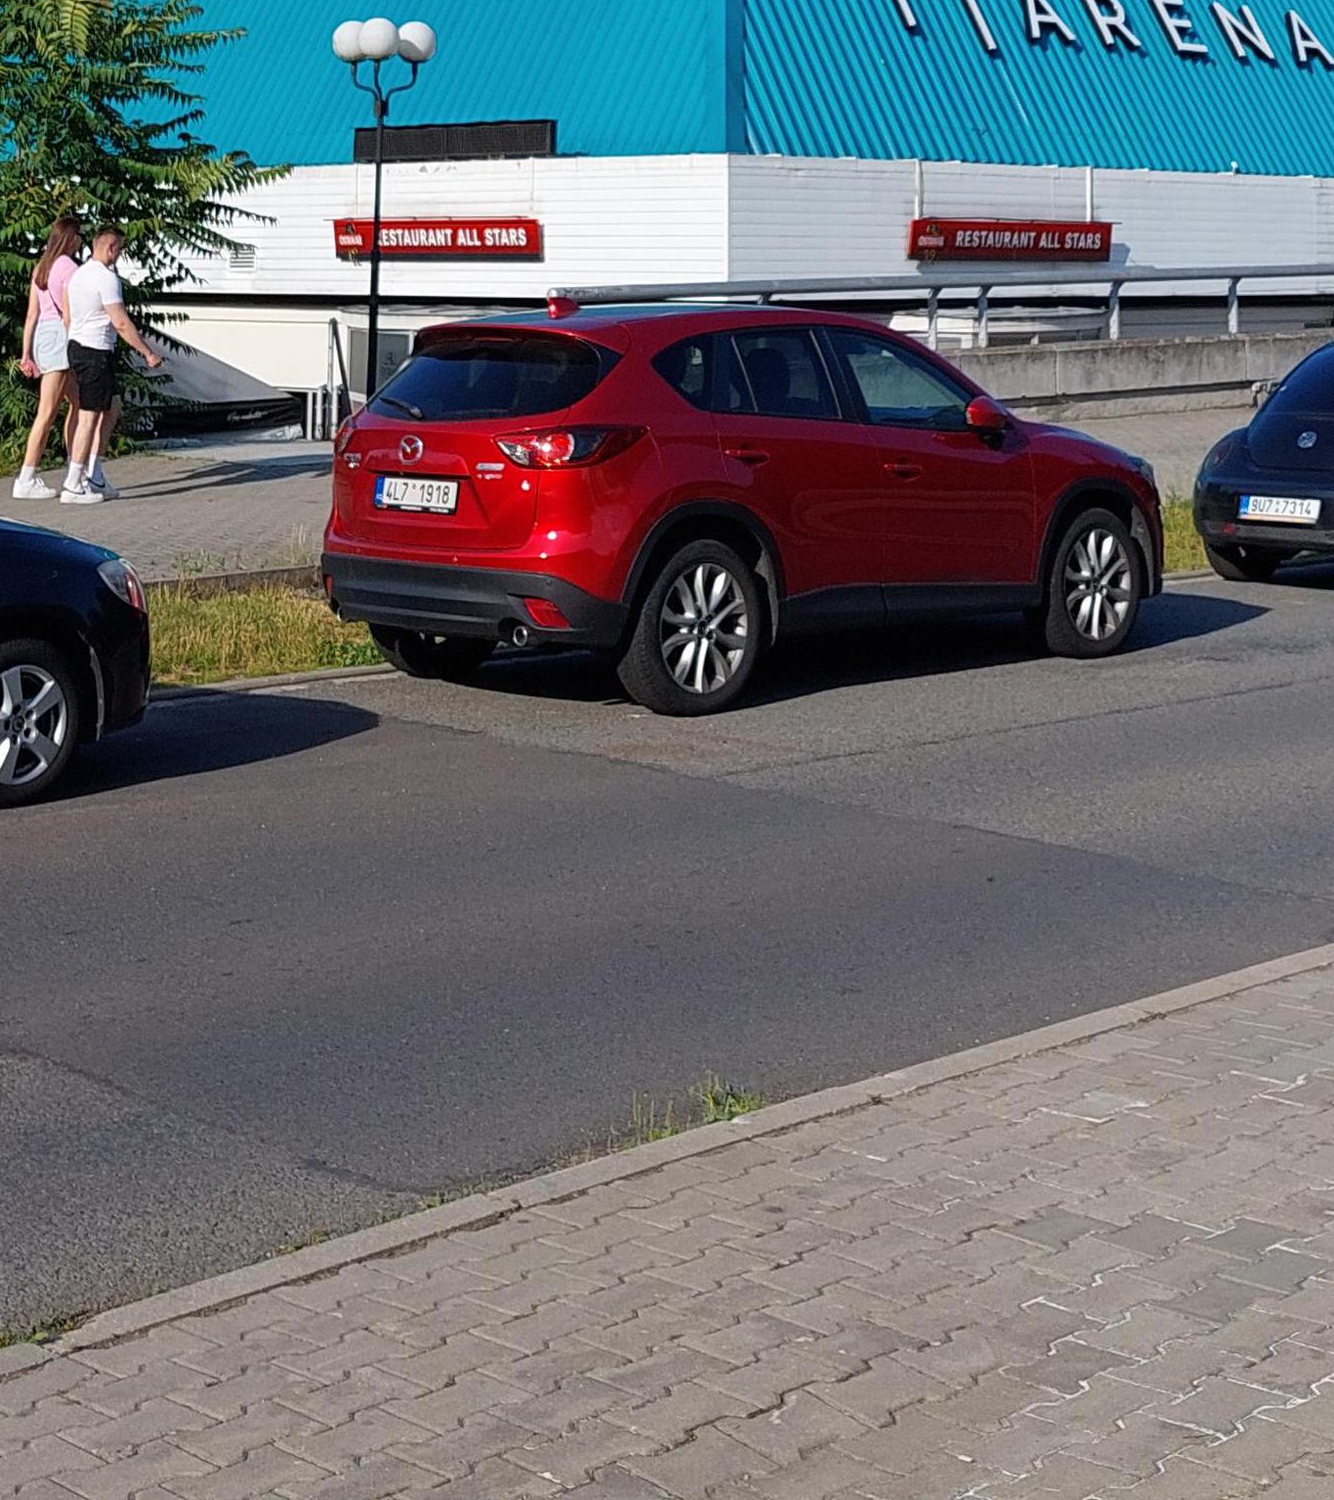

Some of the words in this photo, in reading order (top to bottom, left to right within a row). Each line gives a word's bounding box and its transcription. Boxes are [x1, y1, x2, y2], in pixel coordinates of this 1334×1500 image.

[456, 228, 481, 246] ALL
[484, 228, 527, 246] STARS
[955, 230, 1036, 248] RESTAURANT
[1039, 231, 1061, 248] ALL
[1064, 232, 1101, 249] STARS
[385, 481, 409, 502] 4L7
[419, 483, 451, 505] 1918
